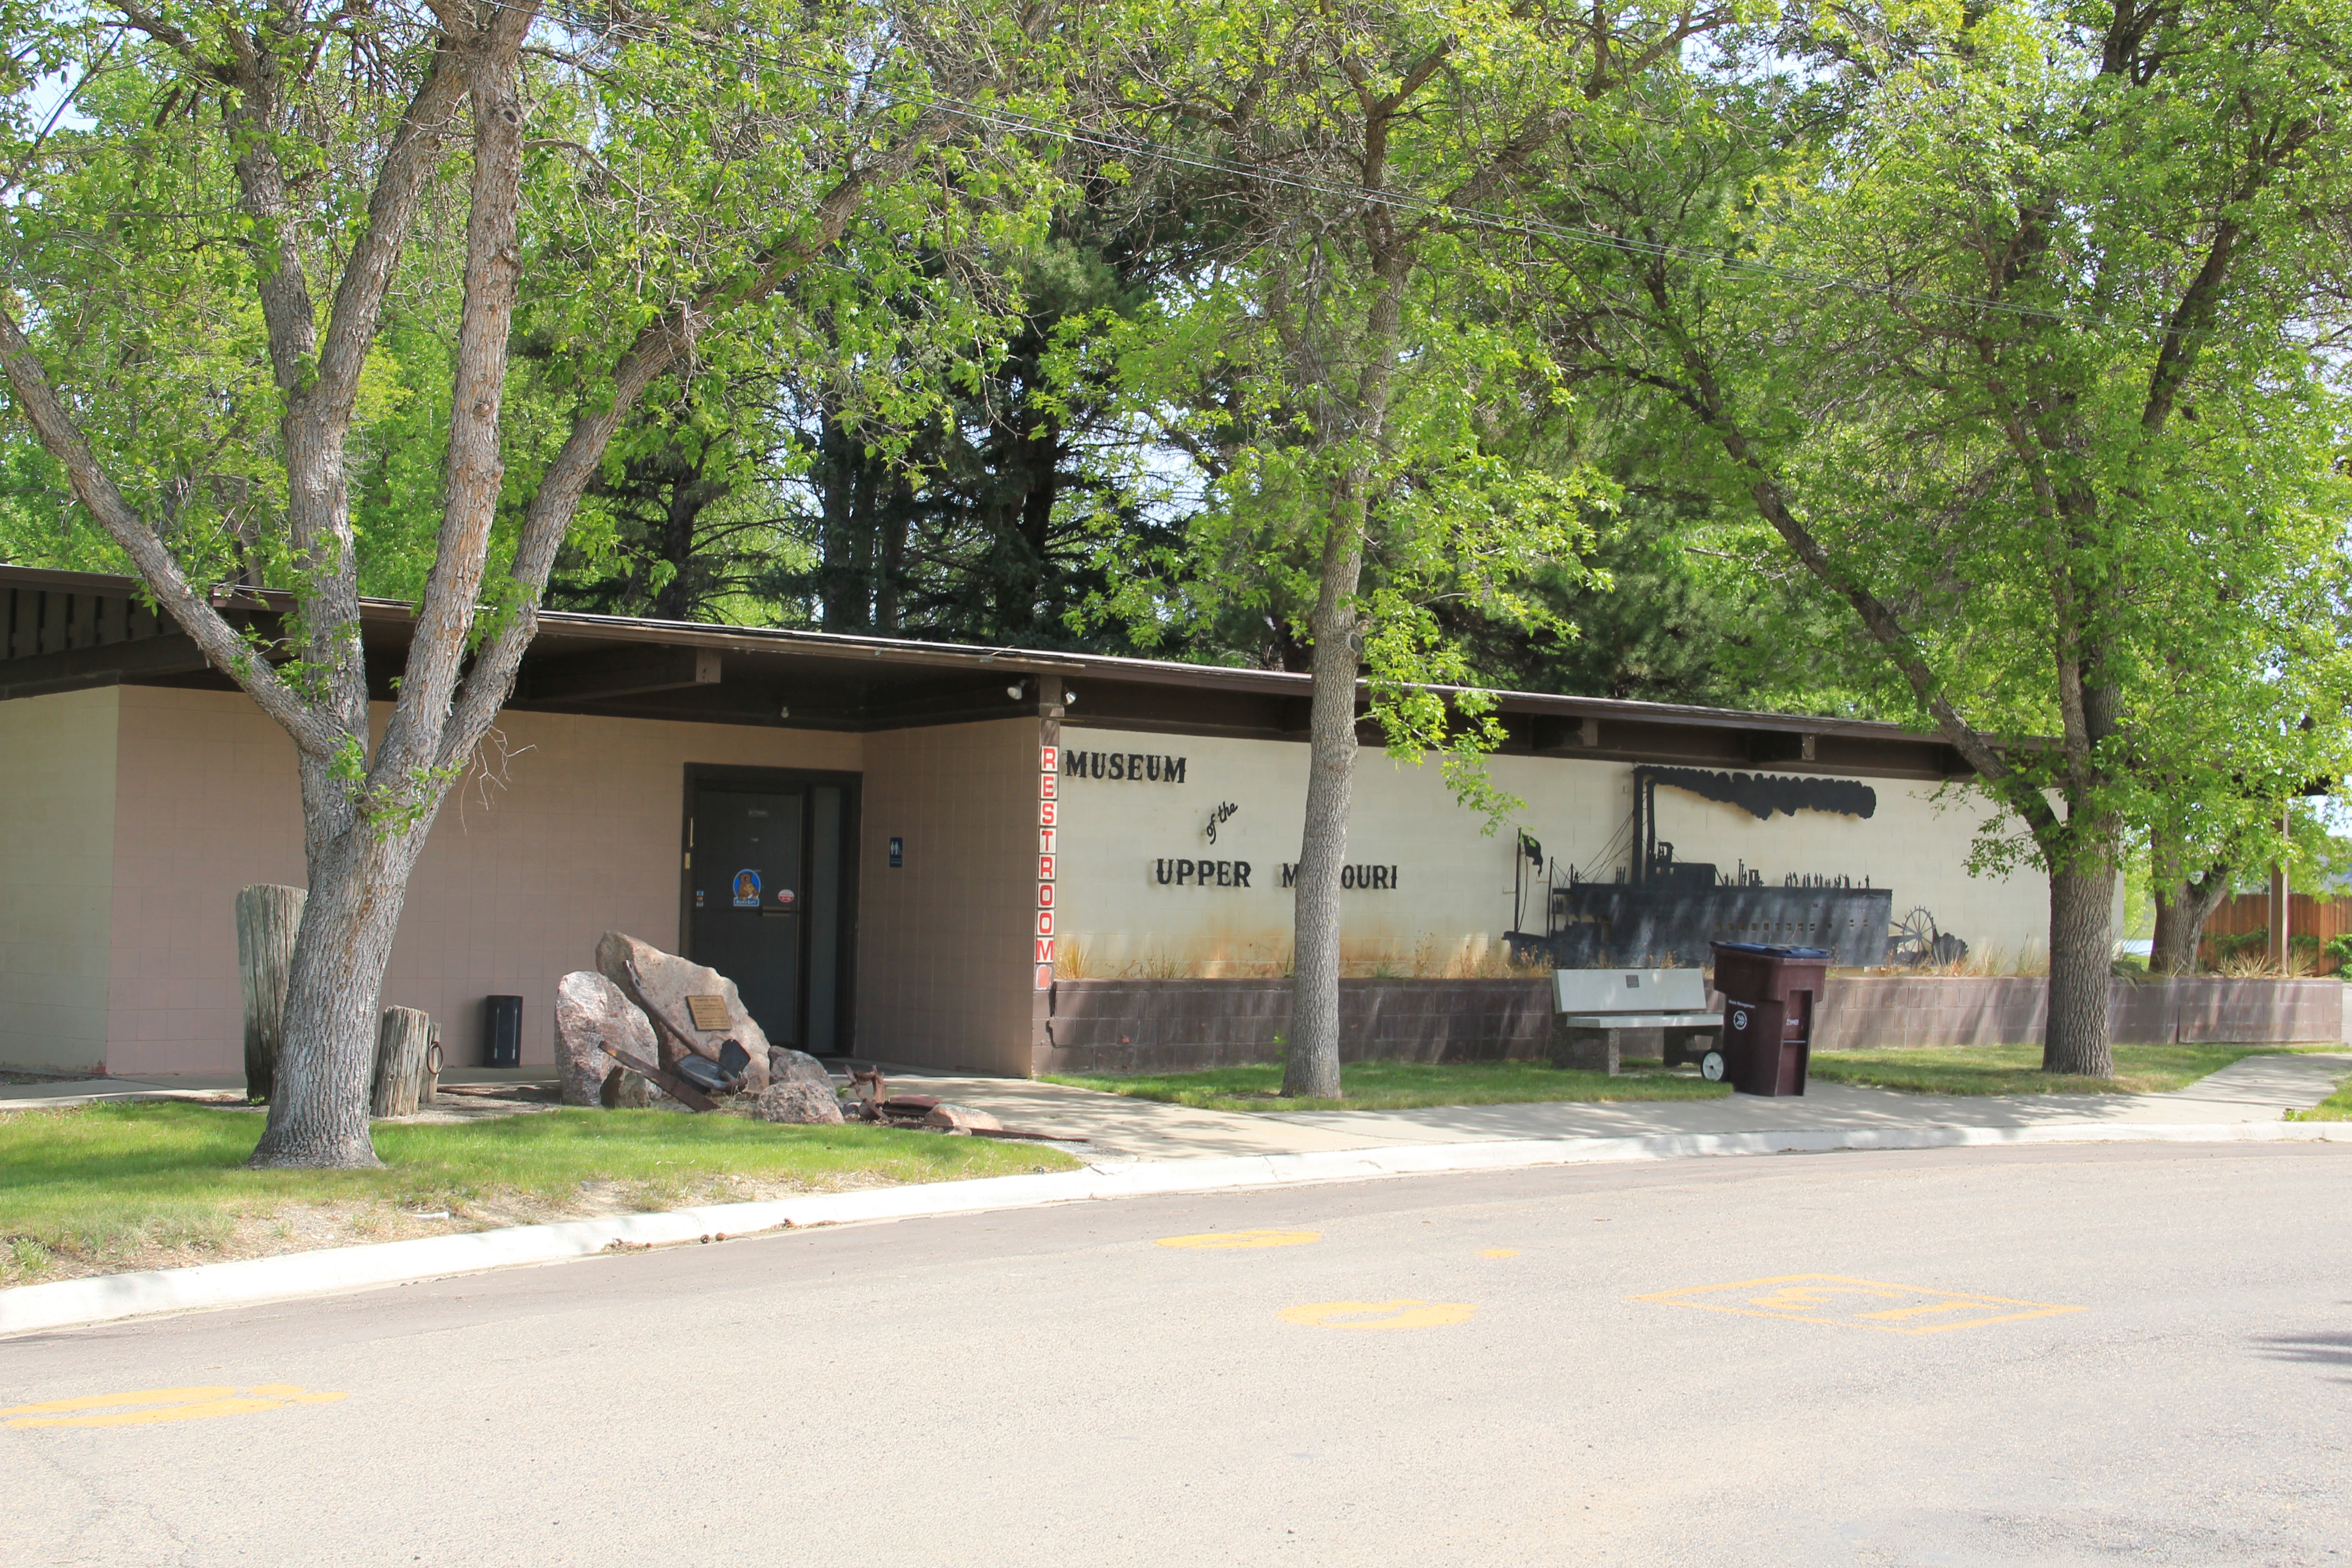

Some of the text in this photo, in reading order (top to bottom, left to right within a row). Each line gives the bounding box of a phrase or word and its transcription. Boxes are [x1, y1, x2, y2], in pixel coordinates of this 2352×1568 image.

[1066, 750, 1187, 784] MUSEUM
[1206, 800, 1238, 845] of the
[1036, 748, 1056, 961] RESTROOM
[1156, 858, 1397, 889] UPPER MOURI
